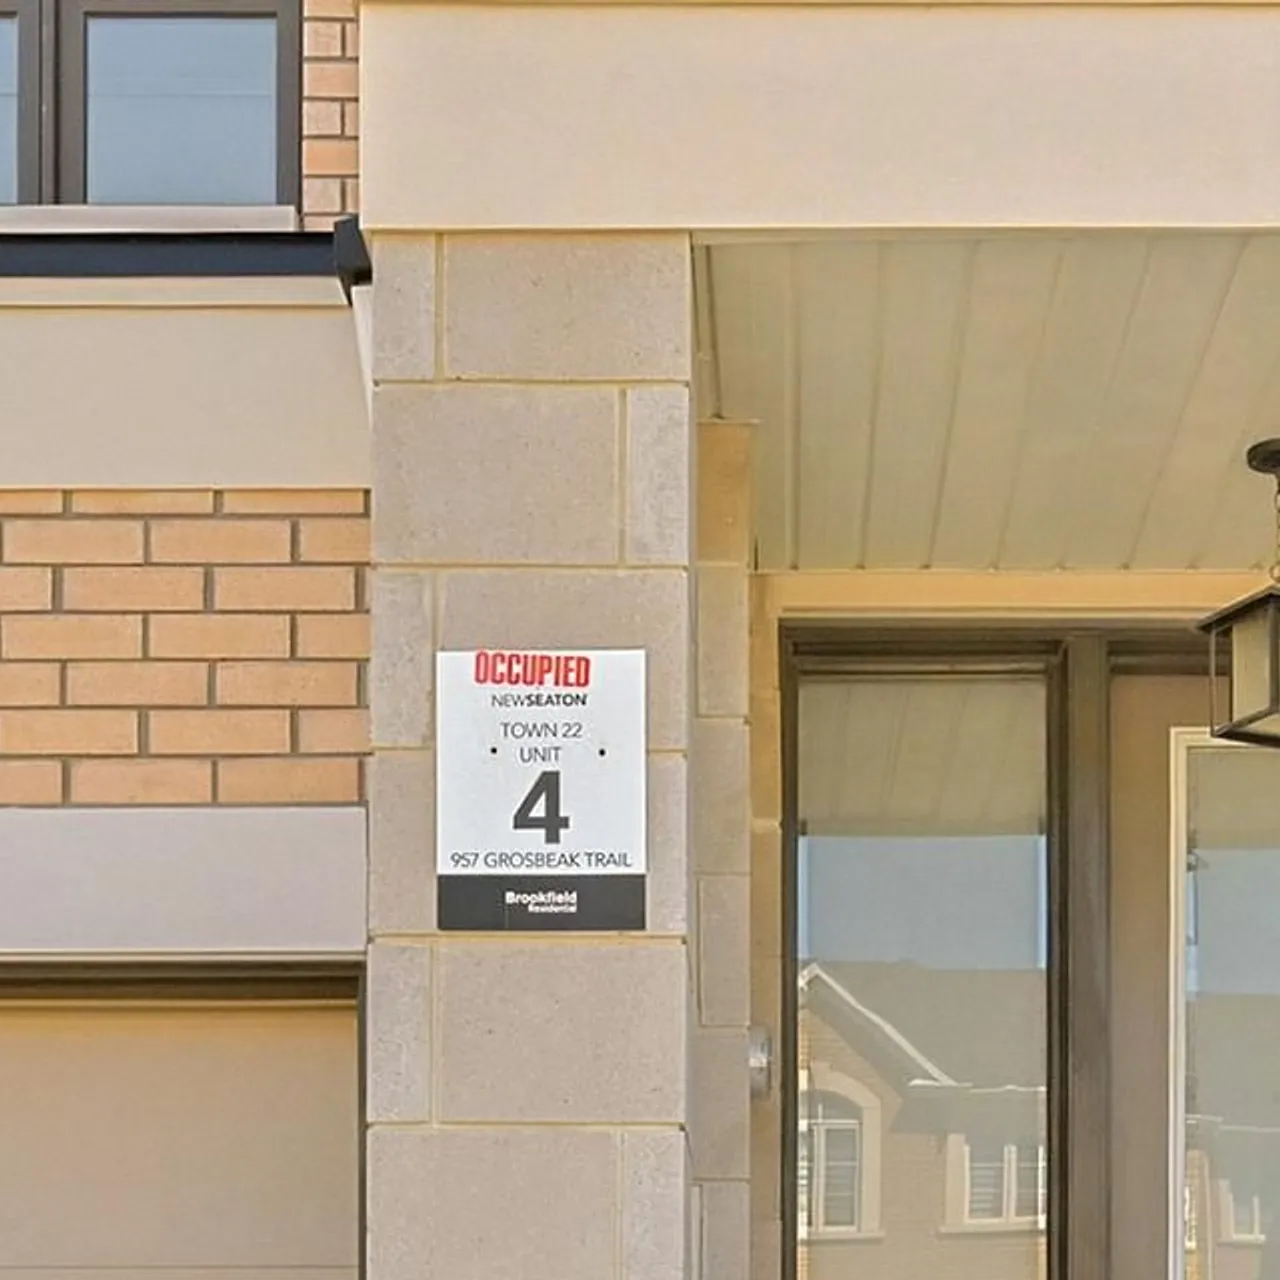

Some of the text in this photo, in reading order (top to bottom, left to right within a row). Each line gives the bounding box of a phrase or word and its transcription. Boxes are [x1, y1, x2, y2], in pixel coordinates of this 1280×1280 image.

[474, 650, 592, 688] OCCUPIED
[500, 722, 583, 739] TOWN 22
[520, 747, 561, 763] UNIT
[512, 769, 570, 845] 4
[450, 851, 632, 868] 957 GROSBEAK TRAIL
[505, 891, 577, 904] Brookfield
